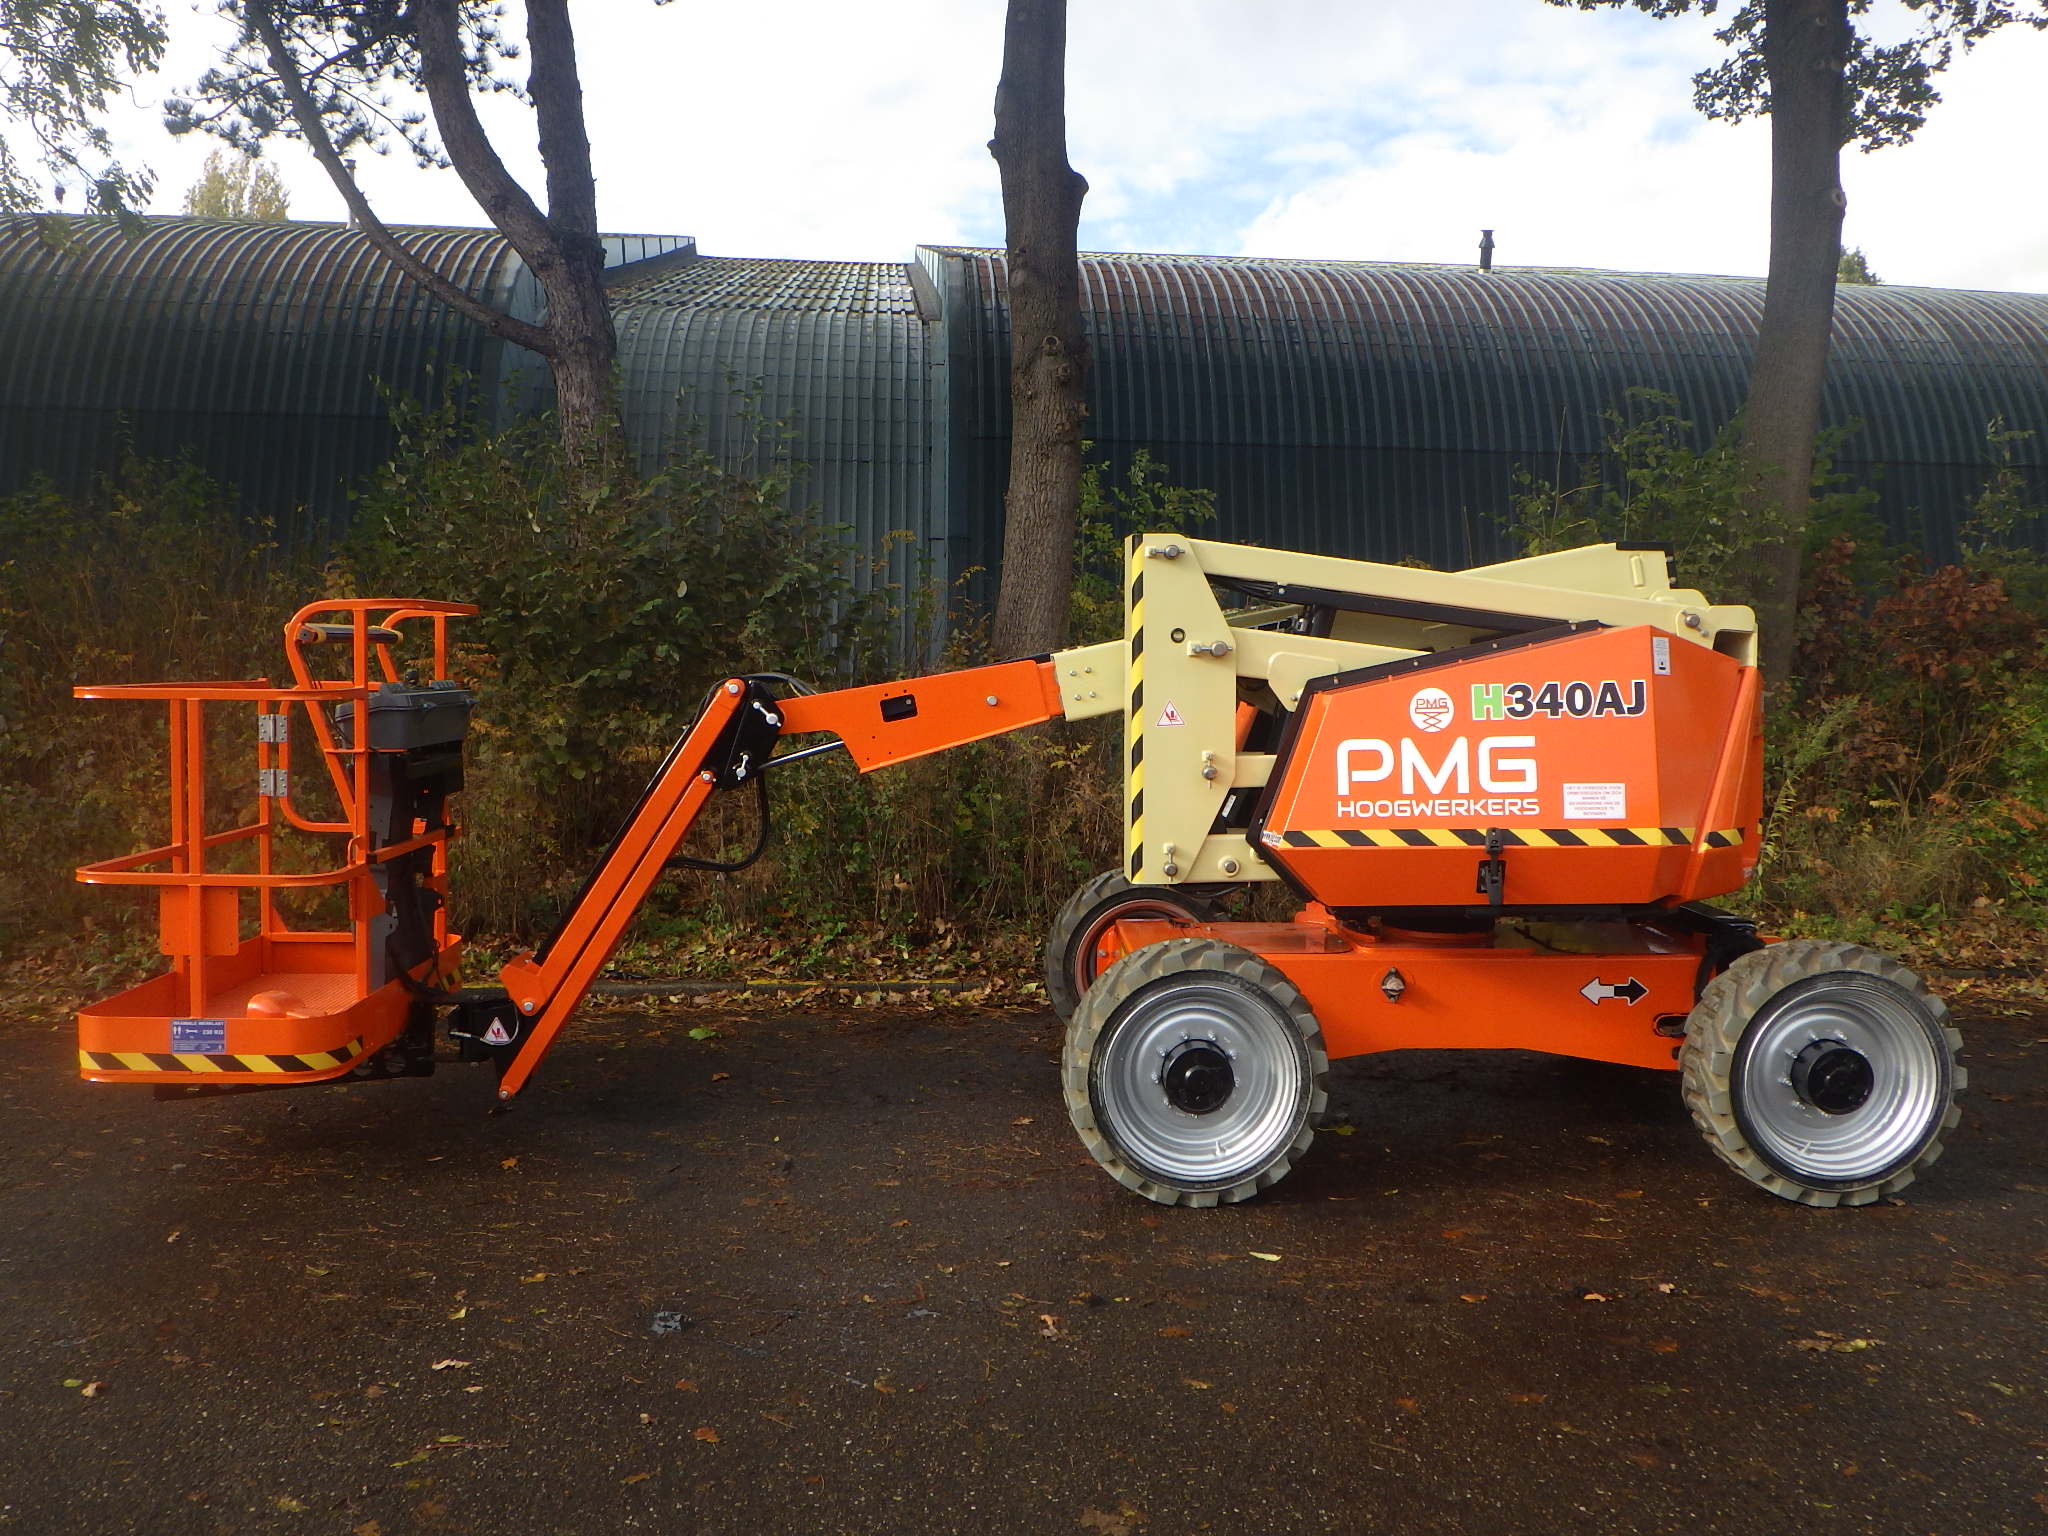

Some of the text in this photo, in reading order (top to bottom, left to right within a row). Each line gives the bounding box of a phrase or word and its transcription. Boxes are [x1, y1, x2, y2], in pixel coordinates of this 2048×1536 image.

[1416, 697, 1448, 709] PMG
[1472, 680, 1646, 720] H340AJ
[1336, 735, 1538, 796] PMG
[1337, 798, 1540, 818] HOOGWERKERS
